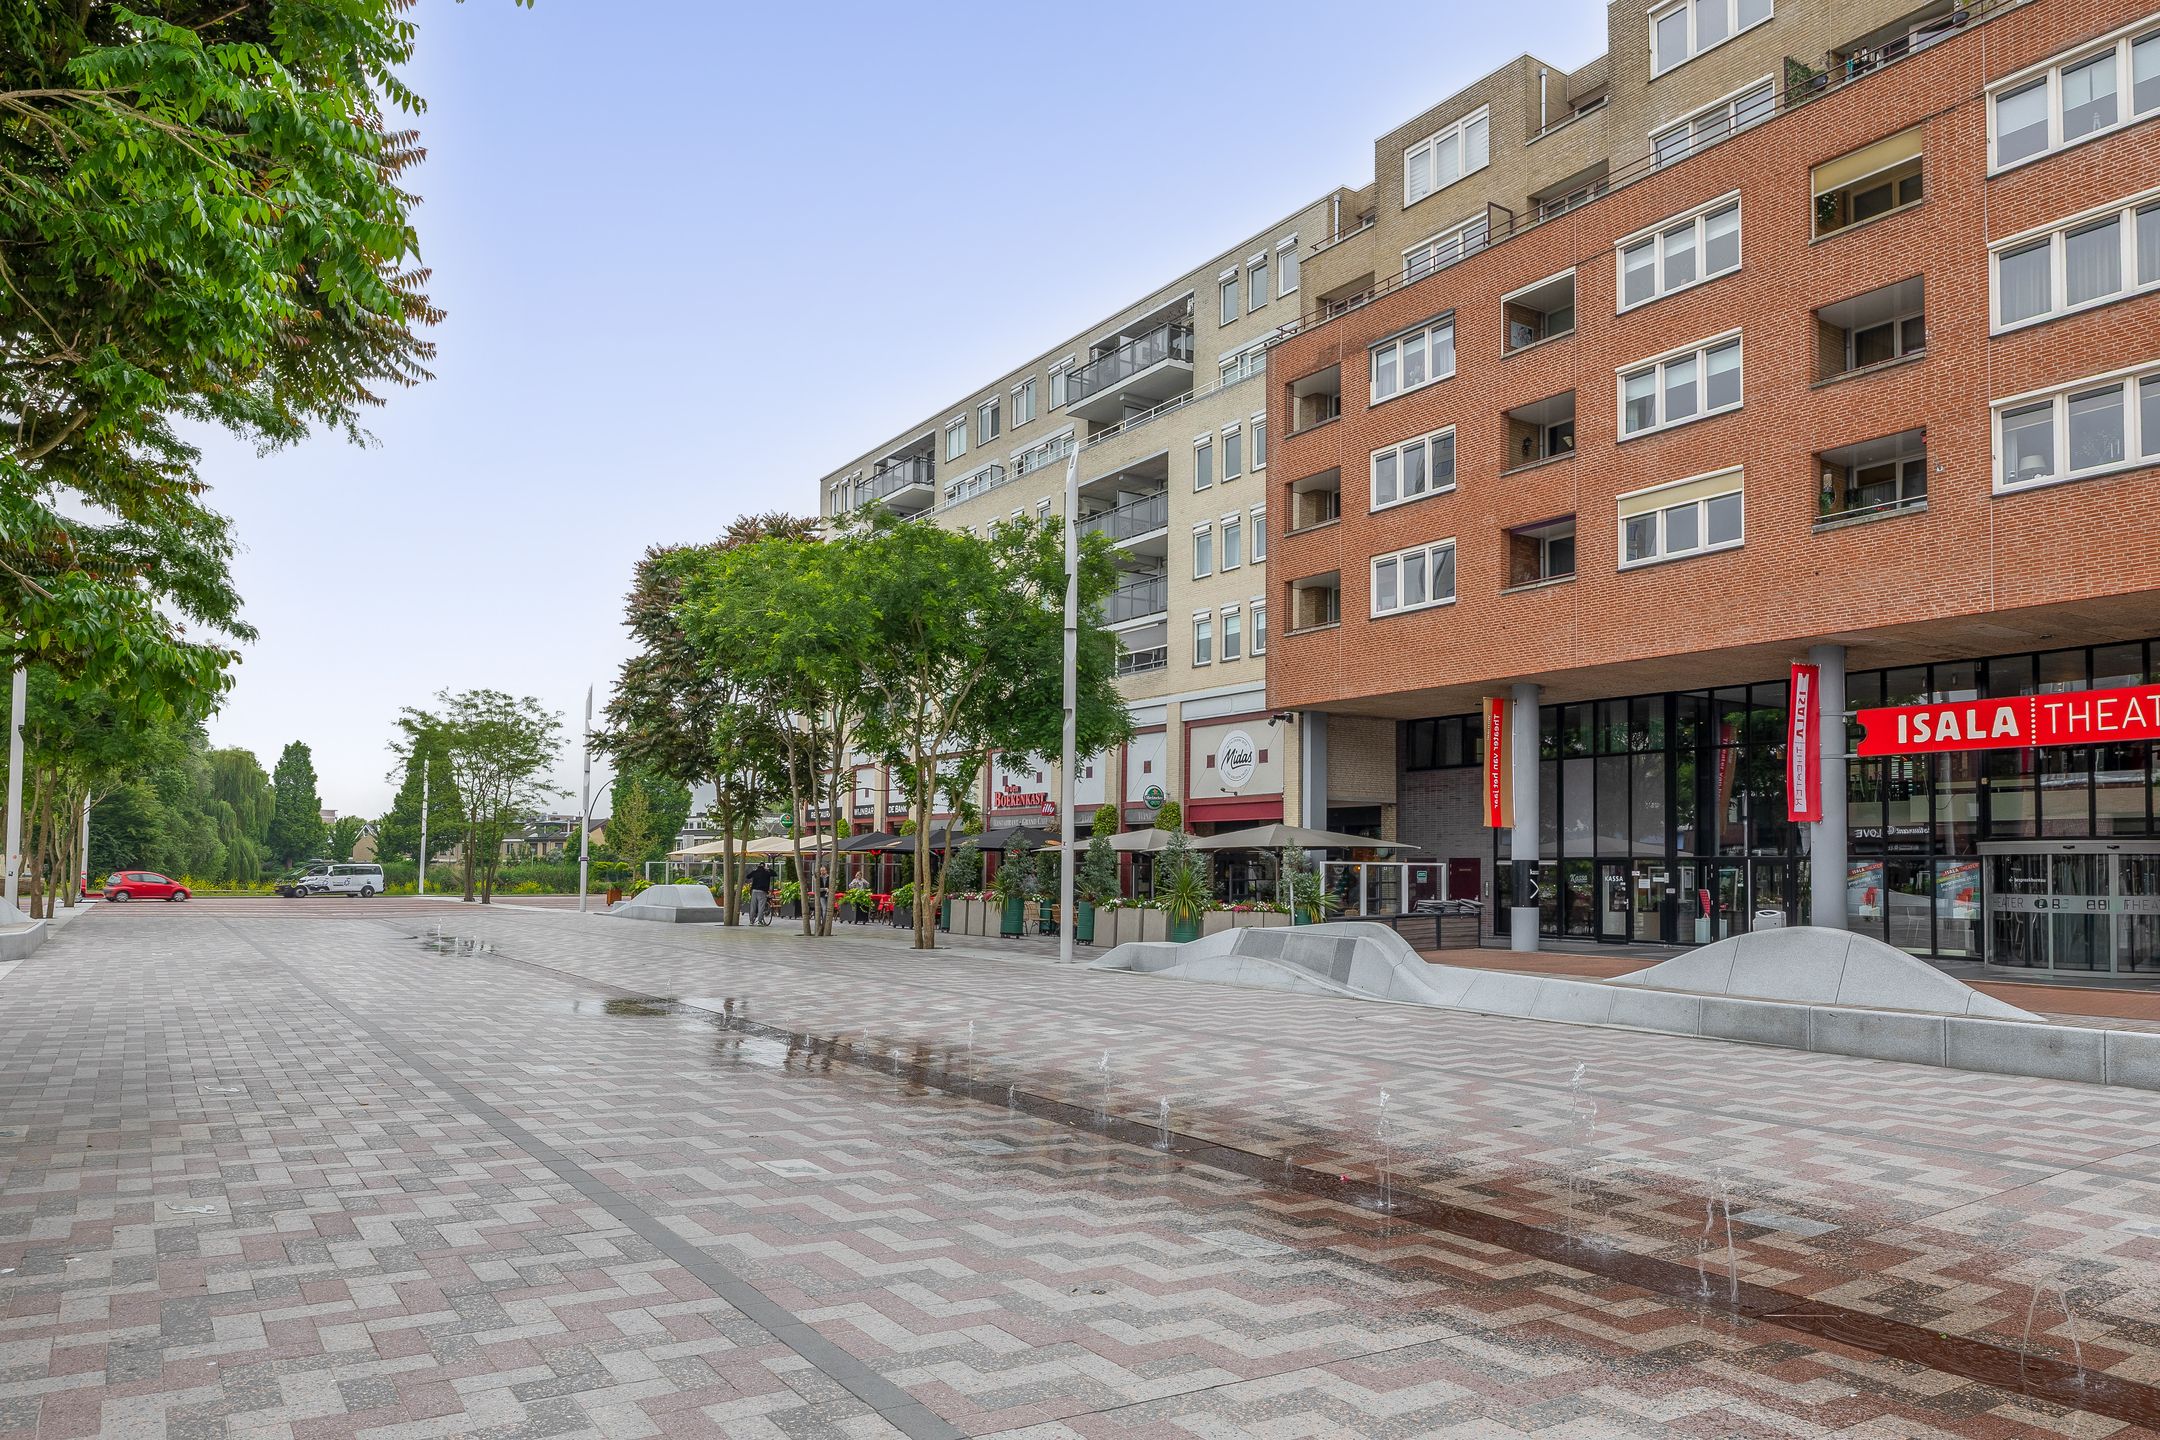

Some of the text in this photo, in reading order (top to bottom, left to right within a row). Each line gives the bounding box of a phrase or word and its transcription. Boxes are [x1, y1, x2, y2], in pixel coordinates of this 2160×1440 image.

[1897, 706, 2020, 744] ISALA
[1221, 748, 1253, 770] Midas
[994, 792, 1046, 807] BOEKENKAST
[888, 805, 908, 814] DE BANK
[1042, 803, 1055, 815] illy
